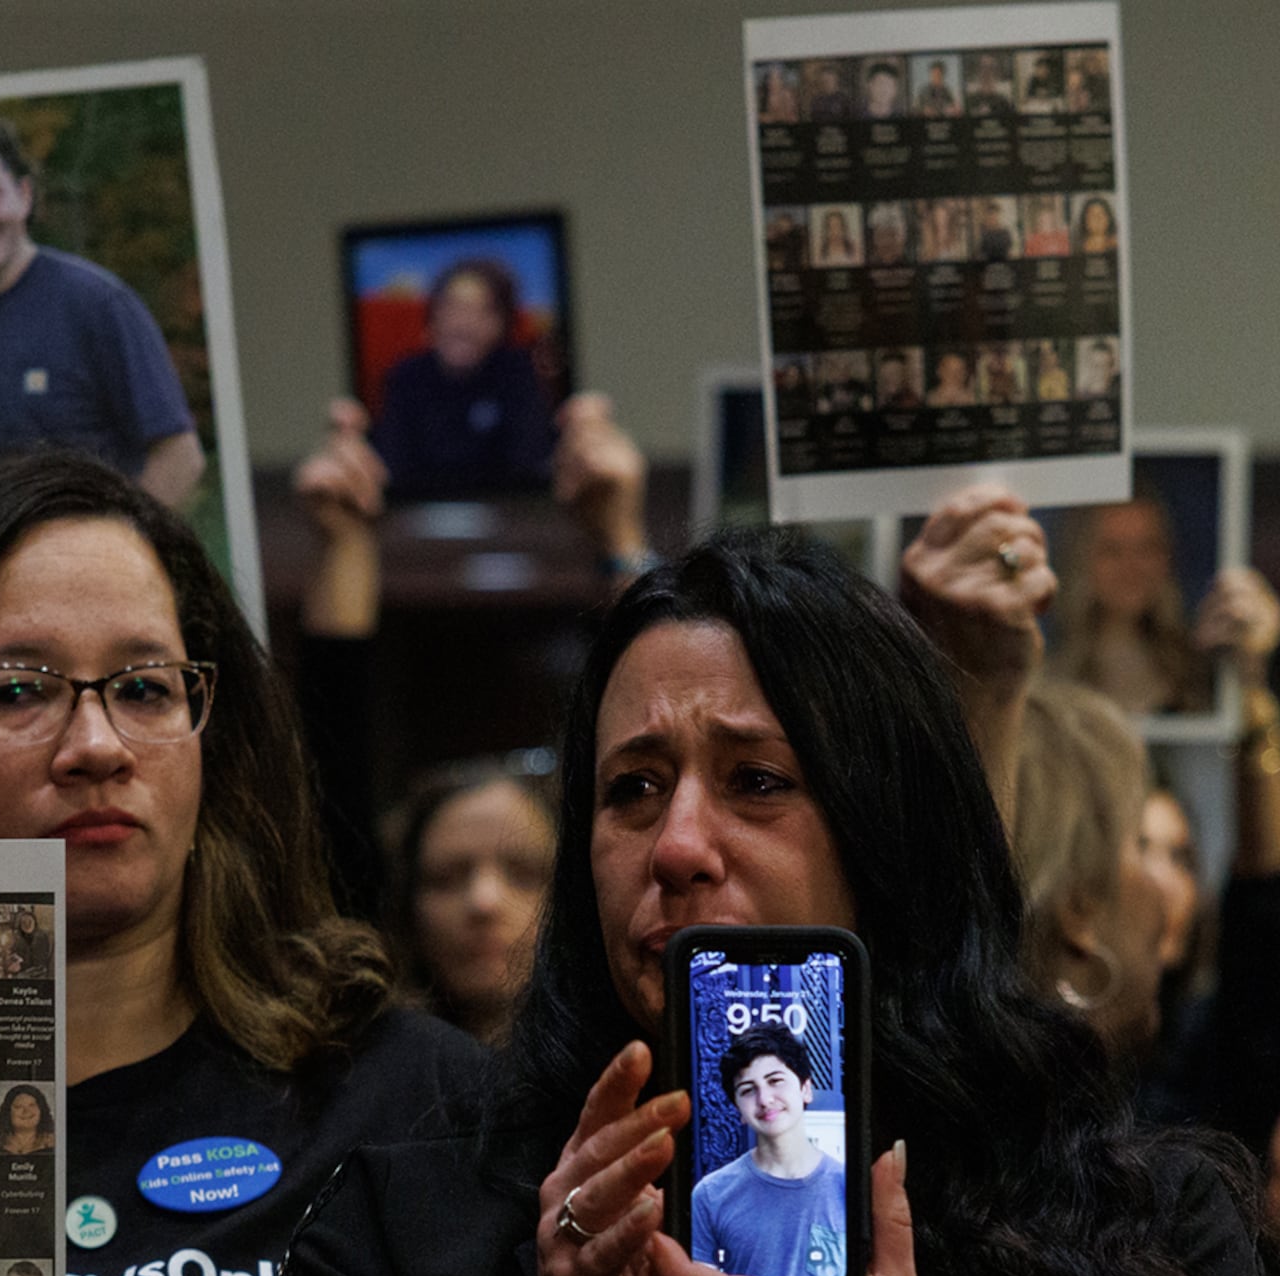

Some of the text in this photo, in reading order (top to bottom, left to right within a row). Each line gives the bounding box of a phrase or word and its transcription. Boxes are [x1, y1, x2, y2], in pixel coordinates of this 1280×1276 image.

[727, 1003, 807, 1035] 9:50
[157, 1143, 259, 1169] Pass KOSA
[11, 1163, 34, 1172] Emily
[141, 1162, 280, 1190] Kids Online Safety Act
[190, 1184, 239, 1203] Now!
[80, 1226, 107, 1240] PACT
